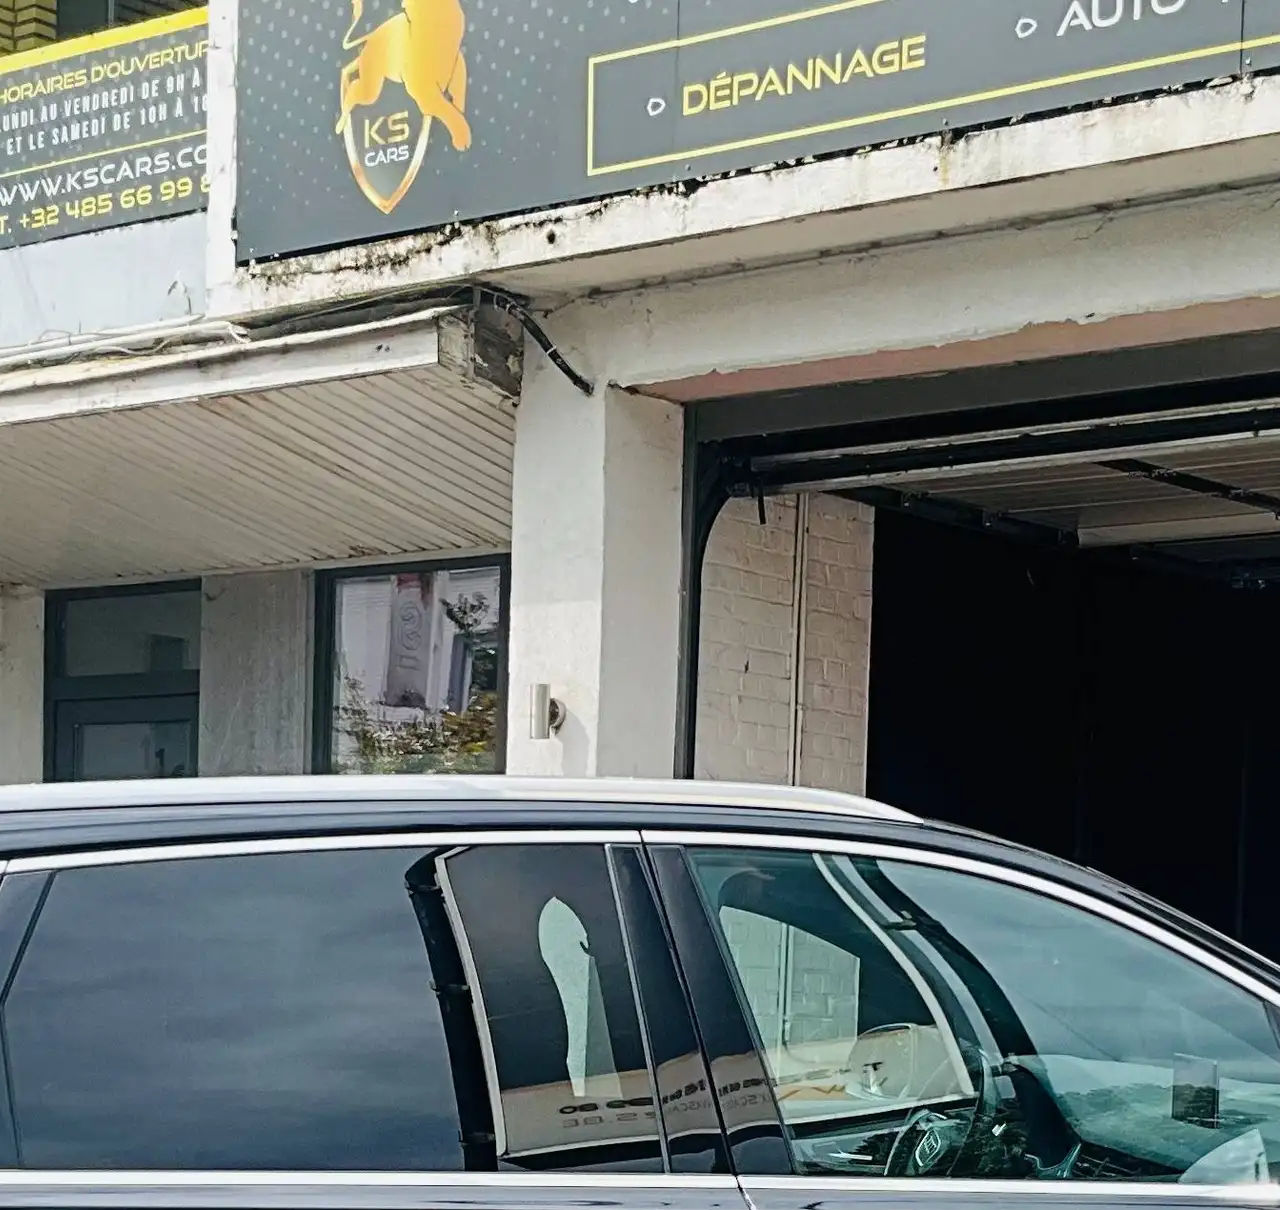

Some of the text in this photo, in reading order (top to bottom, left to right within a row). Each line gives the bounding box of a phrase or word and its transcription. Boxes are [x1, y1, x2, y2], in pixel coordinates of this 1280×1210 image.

[683, 35, 926, 116] DÉPANNAGE
[40, 103, 58, 123] AU
[64, 85, 134, 117] VENDREDI
[142, 79, 160, 99] DE
[6, 136, 22, 156] ET
[29, 131, 45, 151] LE
[52, 116, 106, 146] SAMEDI
[113, 111, 131, 130] DE
[140, 103, 167, 125] 10H
[364, 110, 409, 149] KS
[364, 145, 409, 167] CARS
[20, 204, 60, 229] +32
[65, 192, 113, 219] 485
[120, 184, 153, 209] 66
[160, 177, 193, 202] 99
